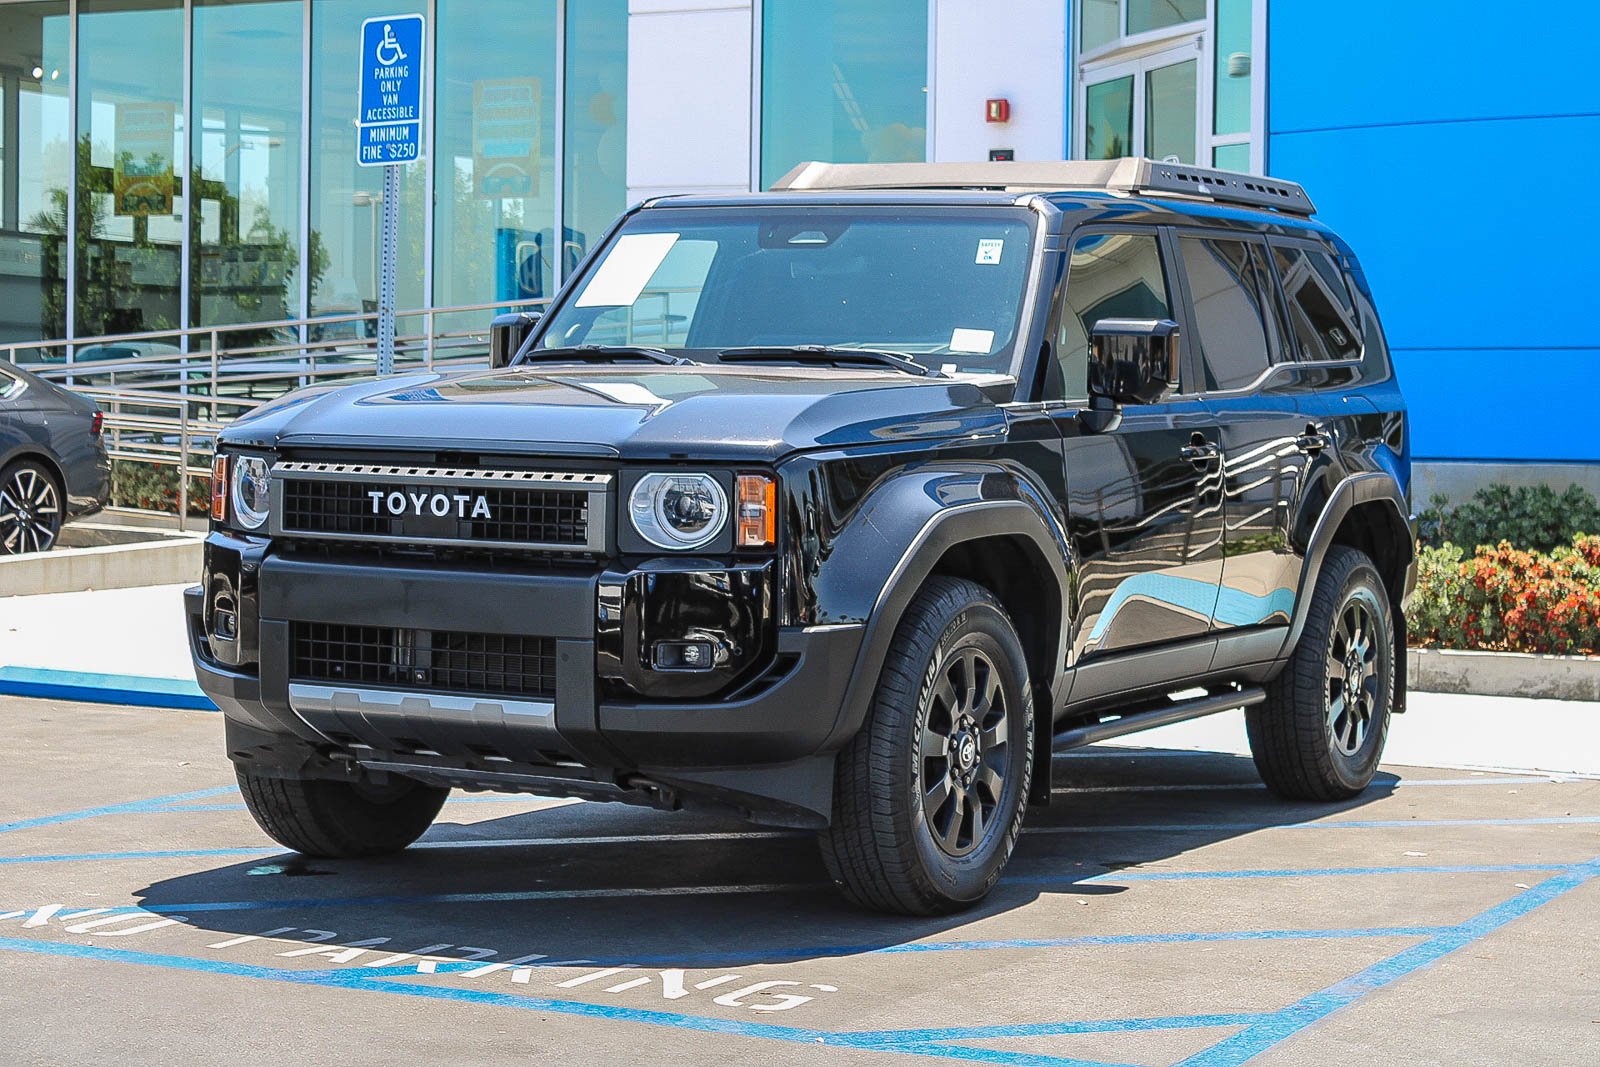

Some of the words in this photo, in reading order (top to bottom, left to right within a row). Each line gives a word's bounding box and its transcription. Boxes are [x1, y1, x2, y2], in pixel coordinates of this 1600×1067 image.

[374, 65, 409, 80] PARKING
[380, 80, 402, 93] ONLY
[382, 93, 399, 106] VAN
[366, 106, 414, 121] ACCESSIBLE
[369, 126, 410, 143] MINIMUM
[362, 145, 383, 160] FINE
[389, 142, 416, 159] $250
[368, 491, 492, 519] TOYOTA
[911, 659, 937, 774] MICHELIN
[1011, 730, 1034, 839] MICHELIN
[0, 903, 189, 936] NO
[206, 927, 838, 1011] PARKING
